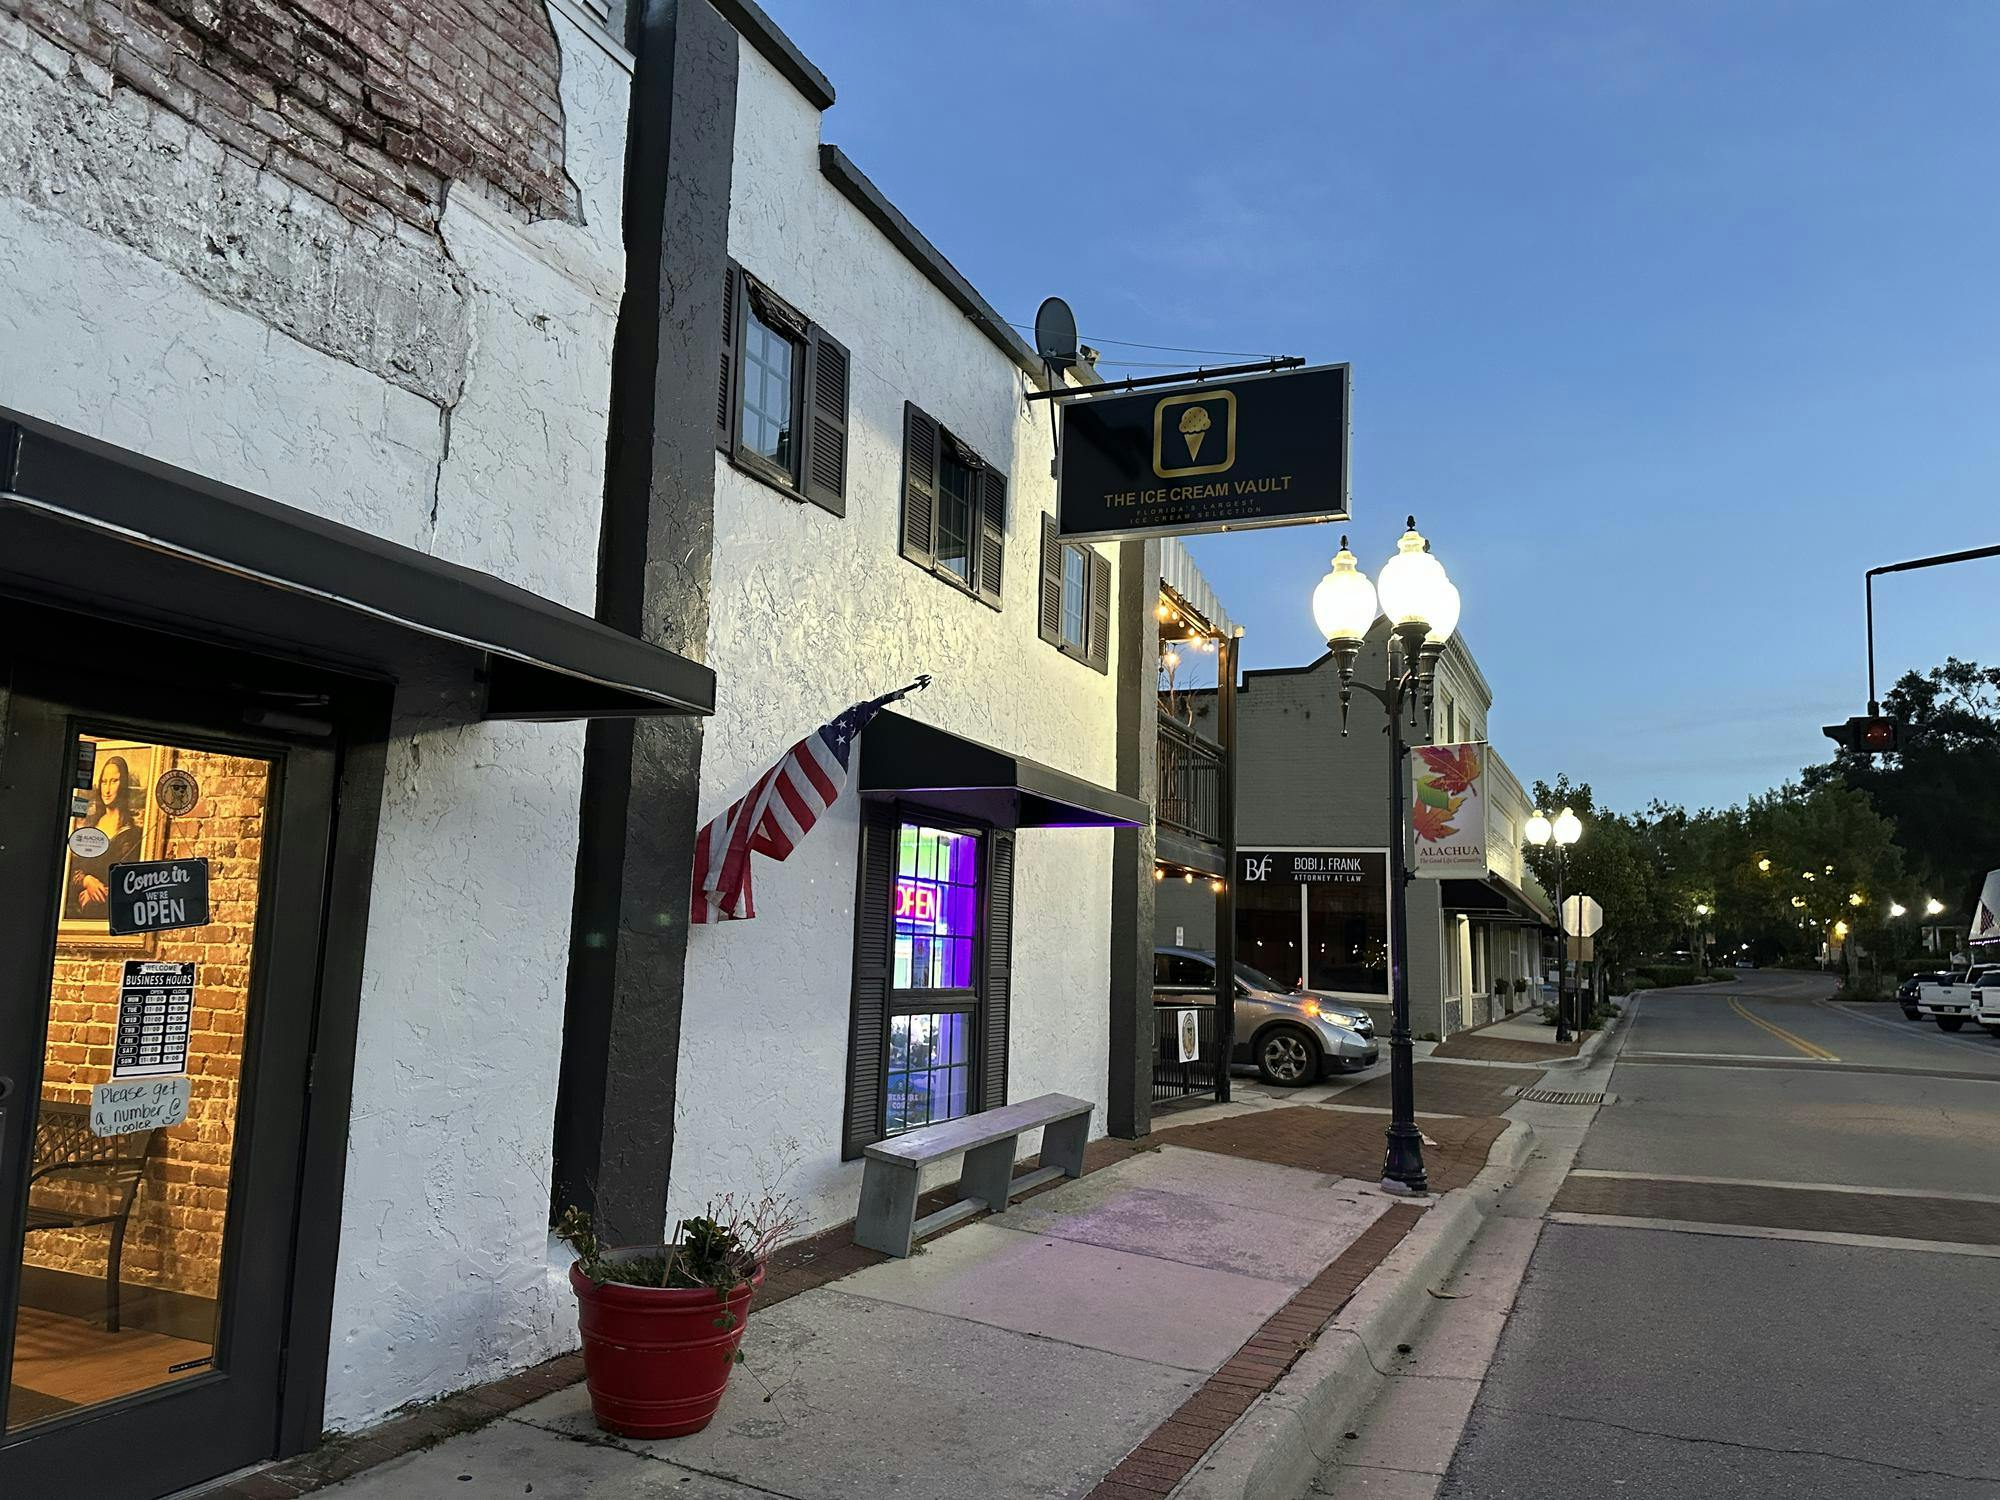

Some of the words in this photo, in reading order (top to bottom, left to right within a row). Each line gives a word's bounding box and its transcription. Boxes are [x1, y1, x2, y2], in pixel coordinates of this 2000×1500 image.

[1104, 493, 1136, 508] THE
[1140, 488, 1167, 504] ICE
[1170, 482, 1229, 501] CREAM
[1234, 475, 1292, 494] VAULT
[1136, 504, 1196, 516] FLORIDA'S
[1203, 499, 1254, 511] LARGEST
[1130, 517, 1148, 525] ICE
[1154, 512, 1191, 523] CREAM
[1198, 506, 1262, 518] SELECTION
[175, 803, 192, 816] SHOP
[1420, 846, 1480, 856] ALACHUA
[1294, 857, 1318, 870] BOBI
[1319, 857, 1326, 871] J.
[1328, 857, 1362, 871] FRANK
[124, 870, 170, 894] Come
[171, 865, 191, 883] in
[1334, 874, 1344, 882] AT
[145, 890, 169, 901] WE'RE
[133, 898, 185, 926] OPEN
[126, 974, 165, 986] BUSINESS
[165, 974, 193, 985] HOURS
[101, 1086, 148, 1105] Please
[152, 1080, 178, 1105] get
[95, 1112, 105, 1126] a
[114, 1103, 165, 1123] number
[99, 1125, 112, 1138] 1st
